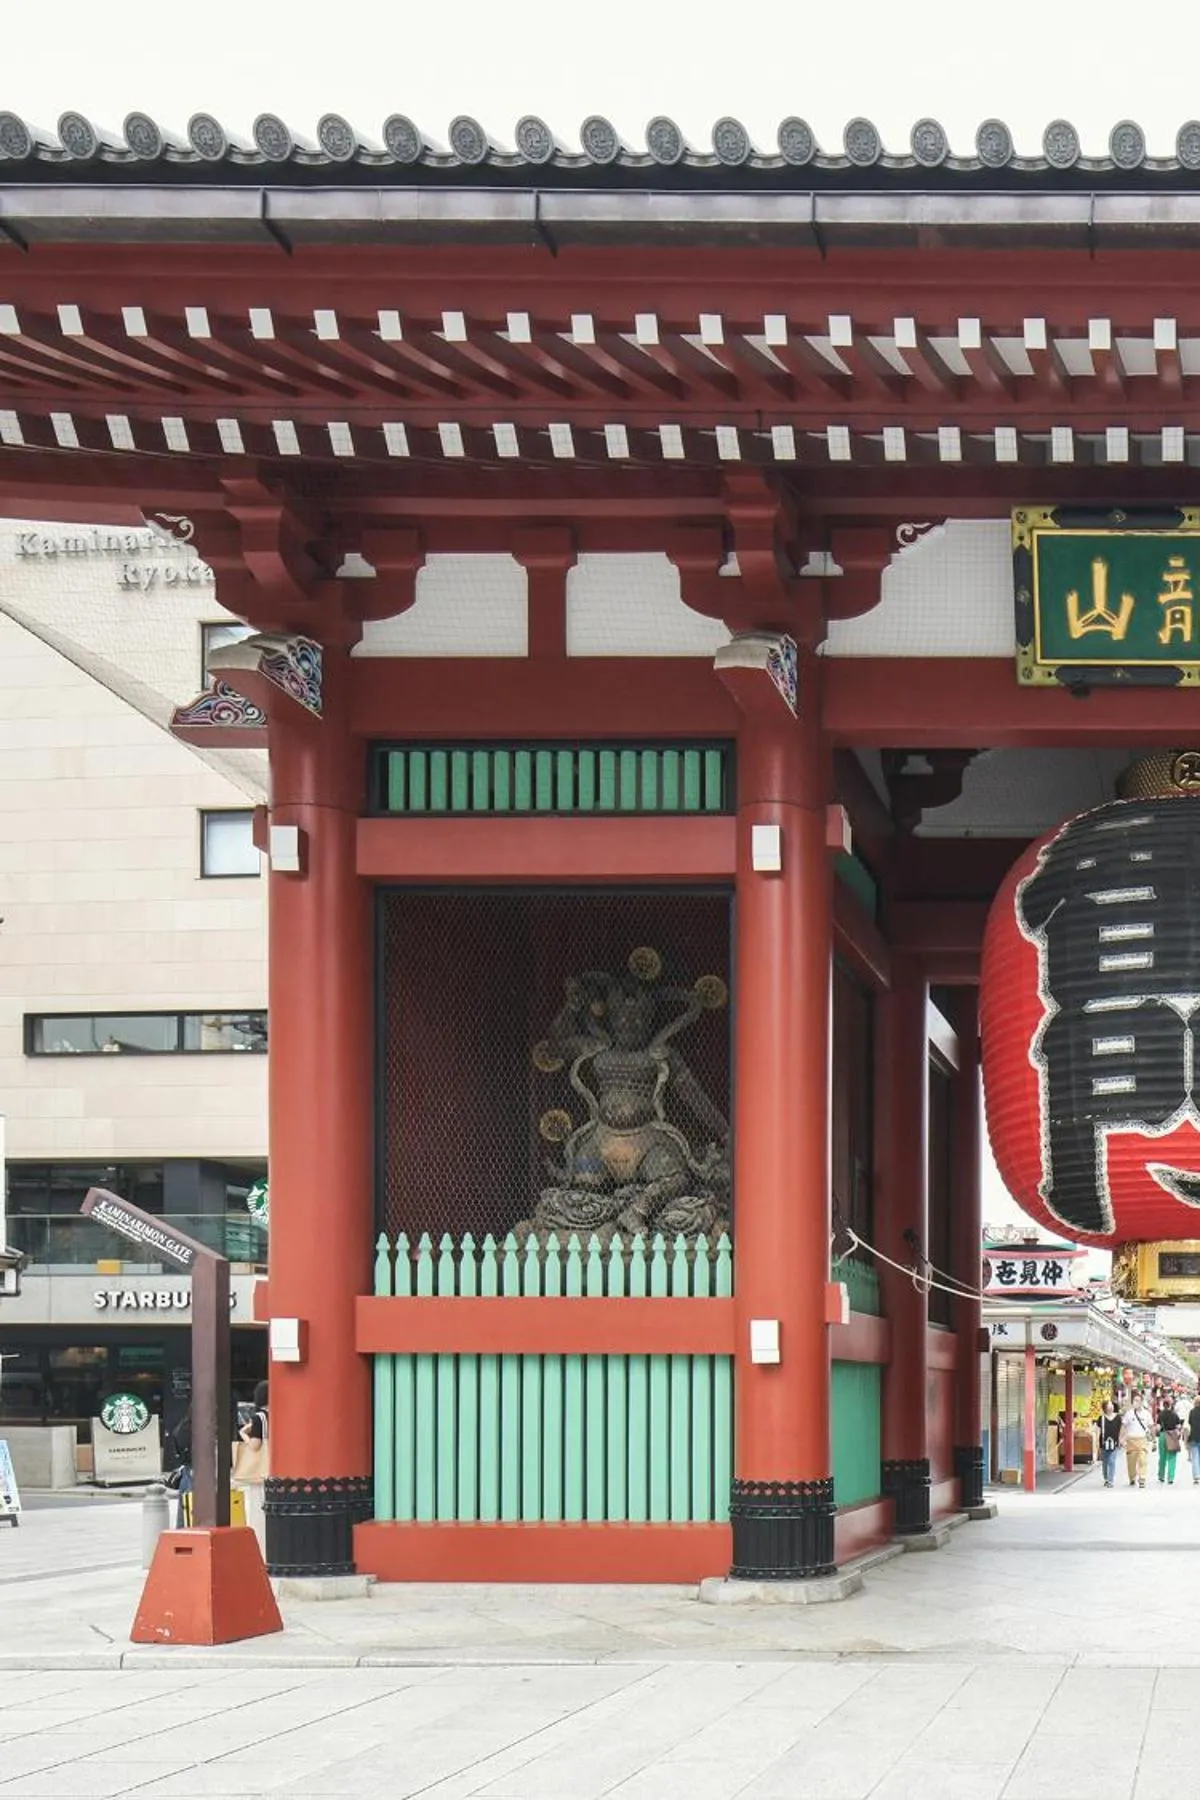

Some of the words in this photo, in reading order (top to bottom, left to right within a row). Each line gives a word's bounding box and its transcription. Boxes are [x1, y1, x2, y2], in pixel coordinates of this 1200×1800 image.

[98, 1200, 167, 1244] KAMINARIMON
[165, 1238, 193, 1259] GATE
[93, 1289, 238, 1310] STARBU
